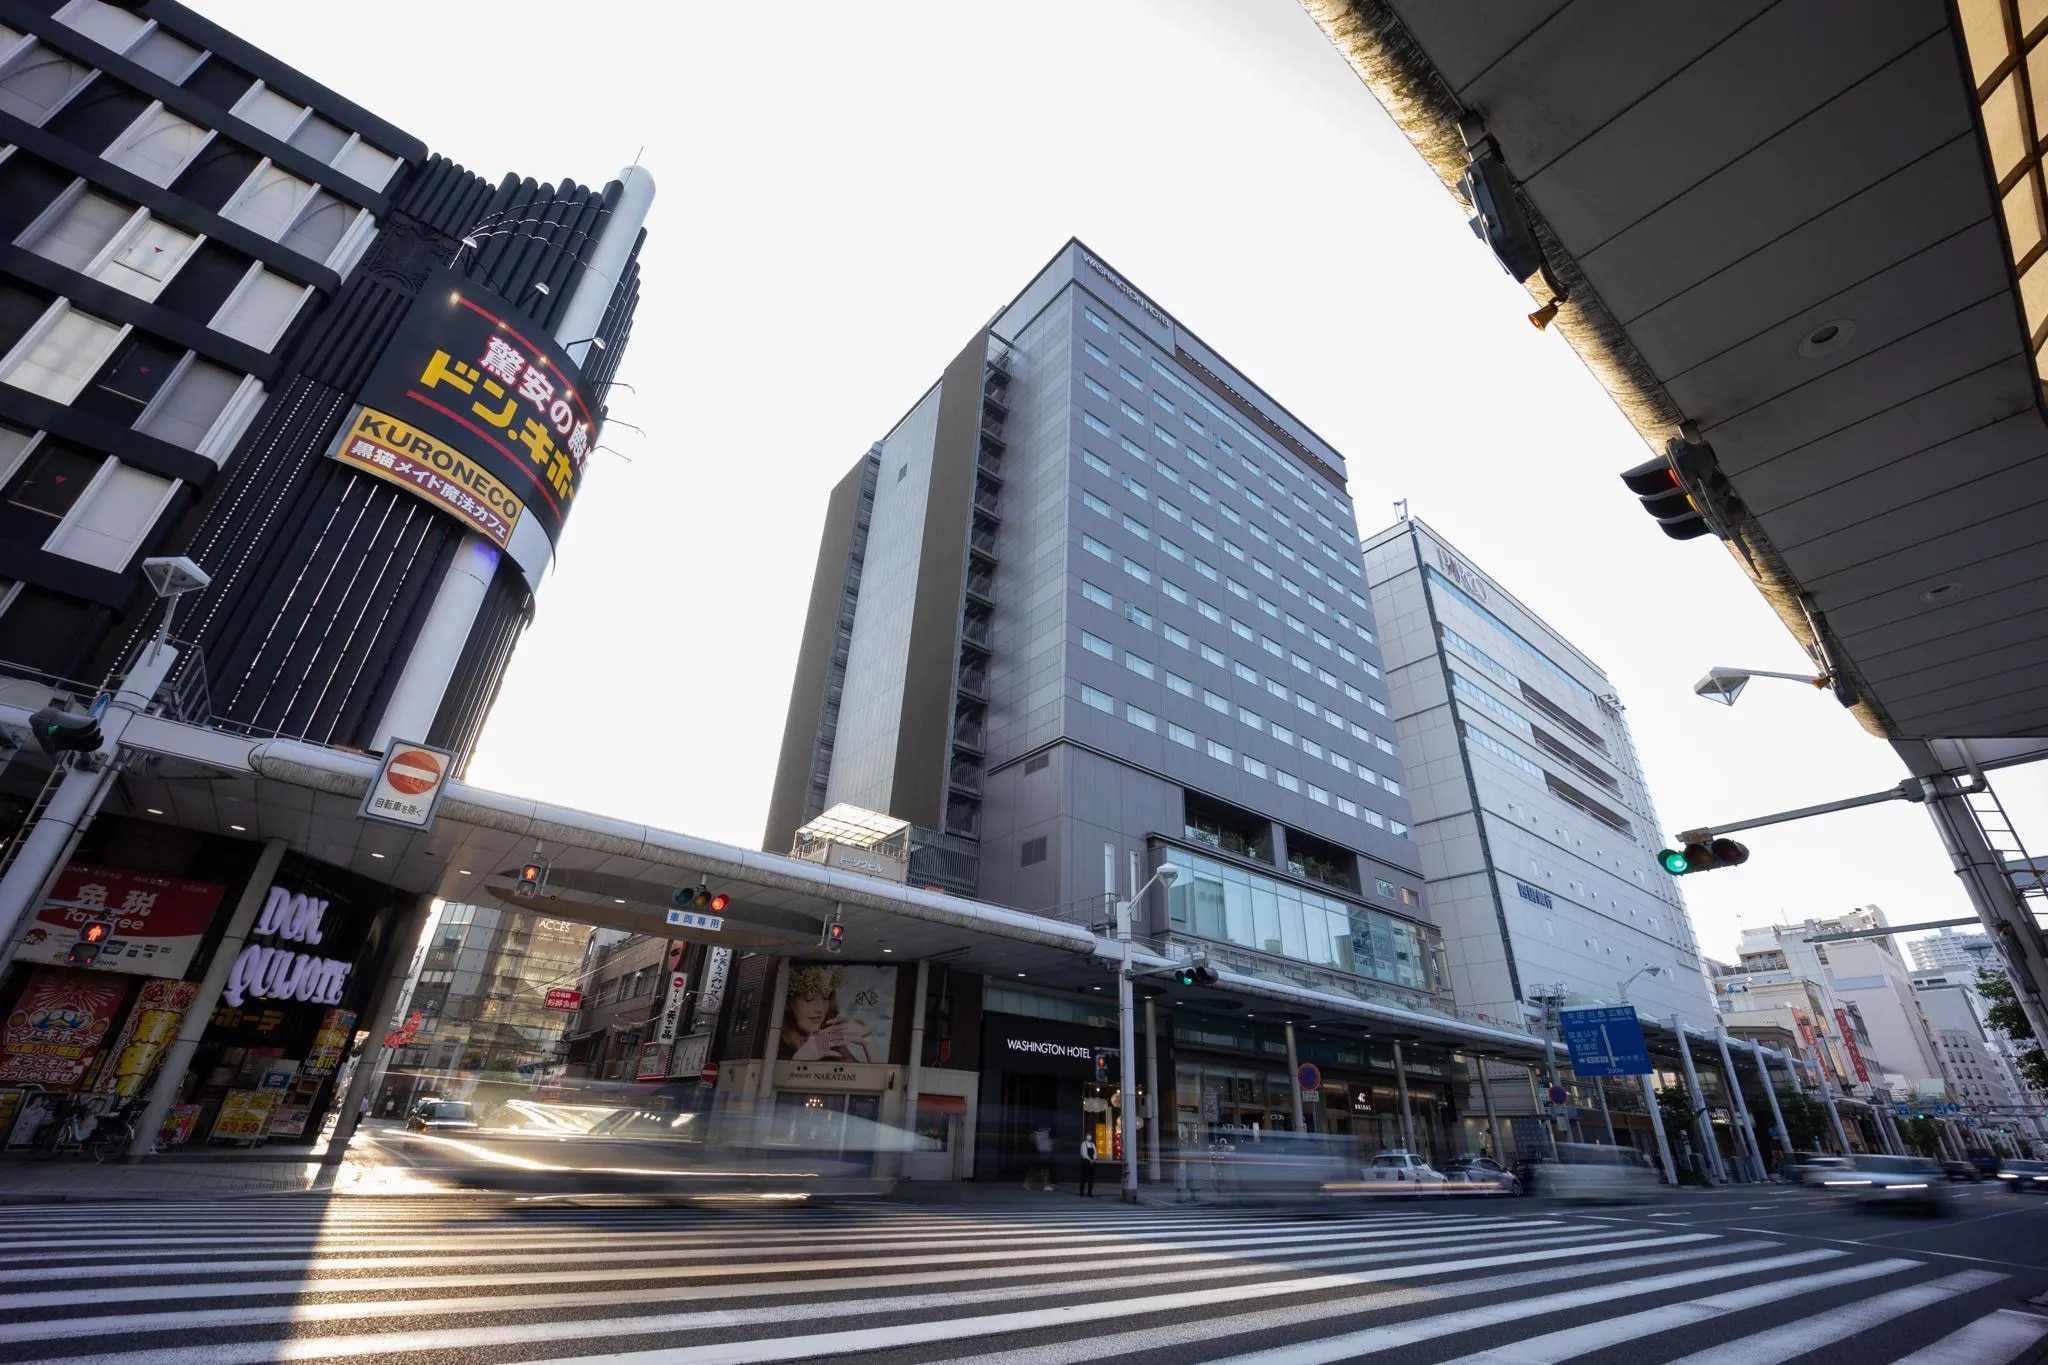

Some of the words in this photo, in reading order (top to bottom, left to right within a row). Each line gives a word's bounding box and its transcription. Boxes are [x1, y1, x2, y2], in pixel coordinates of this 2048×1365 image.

[1082, 252, 1144, 307] WASHINGTON
[1144, 302, 1170, 328] HOTEL
[359, 415, 518, 519] KURONECO
[375, 797, 424, 817] 自転車を除く
[77, 882, 159, 917] 免税
[254, 885, 331, 945] DON
[670, 912, 720, 928] 車両専用
[223, 943, 352, 1008] QUIJOTE
[5, 1028, 101, 1046] ドン・キホーテ
[1006, 1038, 1066, 1056] WASHINGTON
[1066, 1046, 1091, 1059] HOTEL
[813, 1072, 856, 1082] NAKATANI
